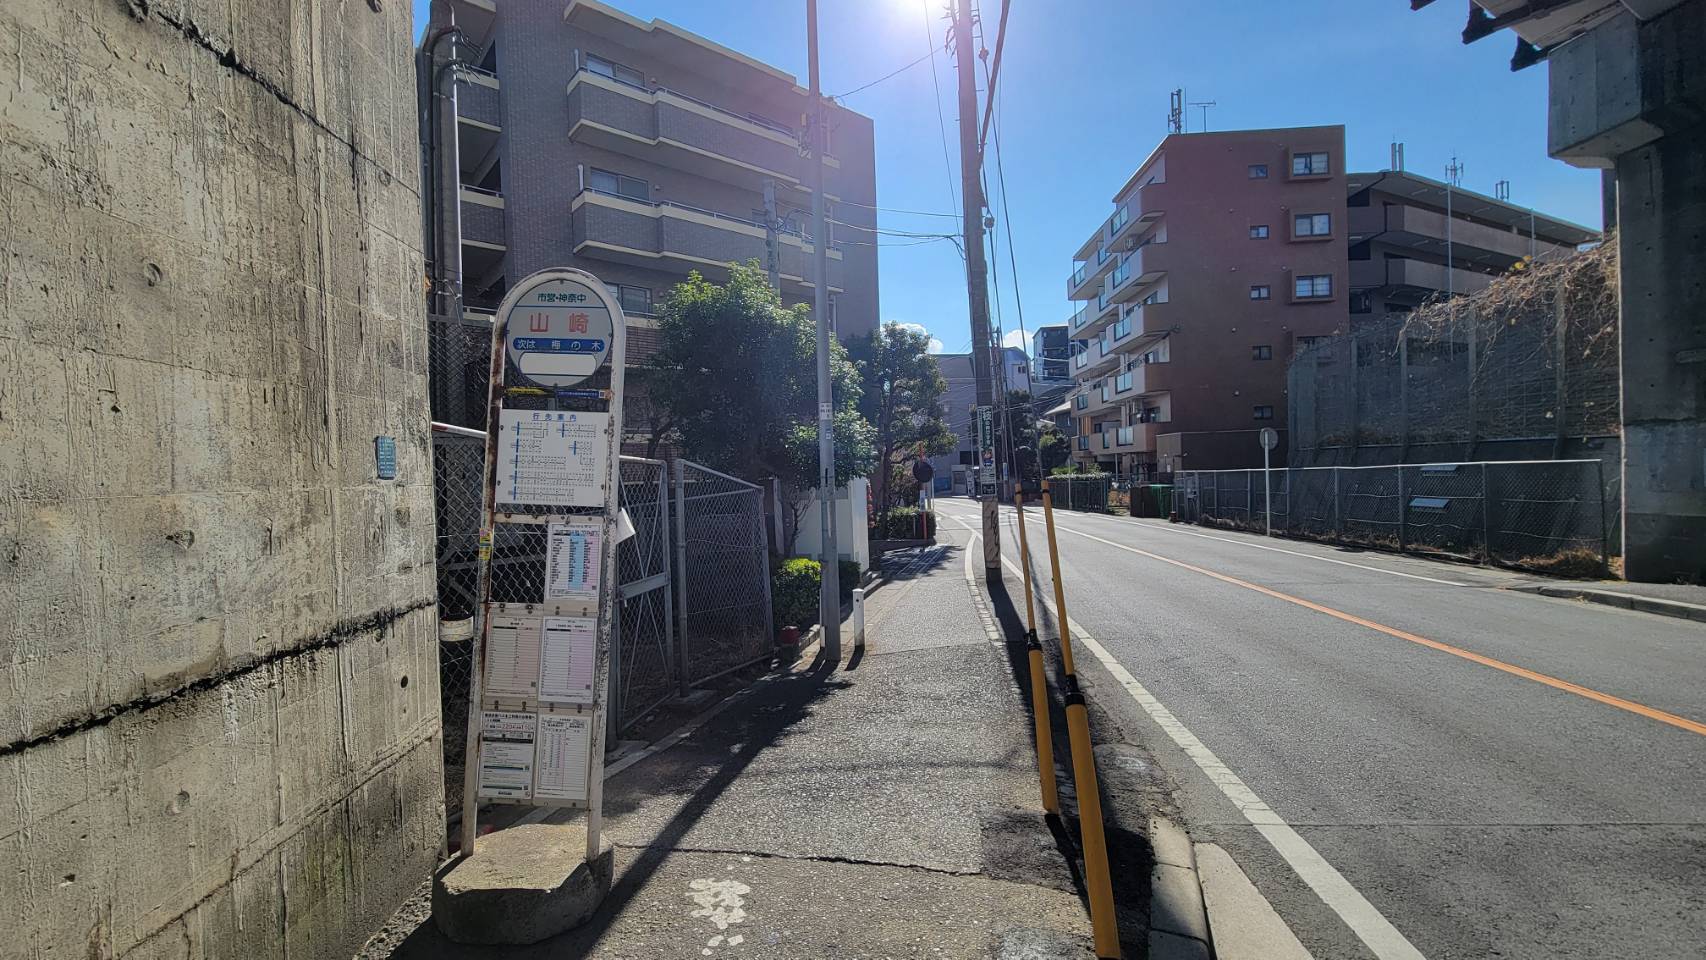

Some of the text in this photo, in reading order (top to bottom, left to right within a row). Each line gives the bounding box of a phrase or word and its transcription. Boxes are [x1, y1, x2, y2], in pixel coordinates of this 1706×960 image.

[529, 312, 589, 334] 山崎
[517, 339, 601, 351] 次は 梅の木
